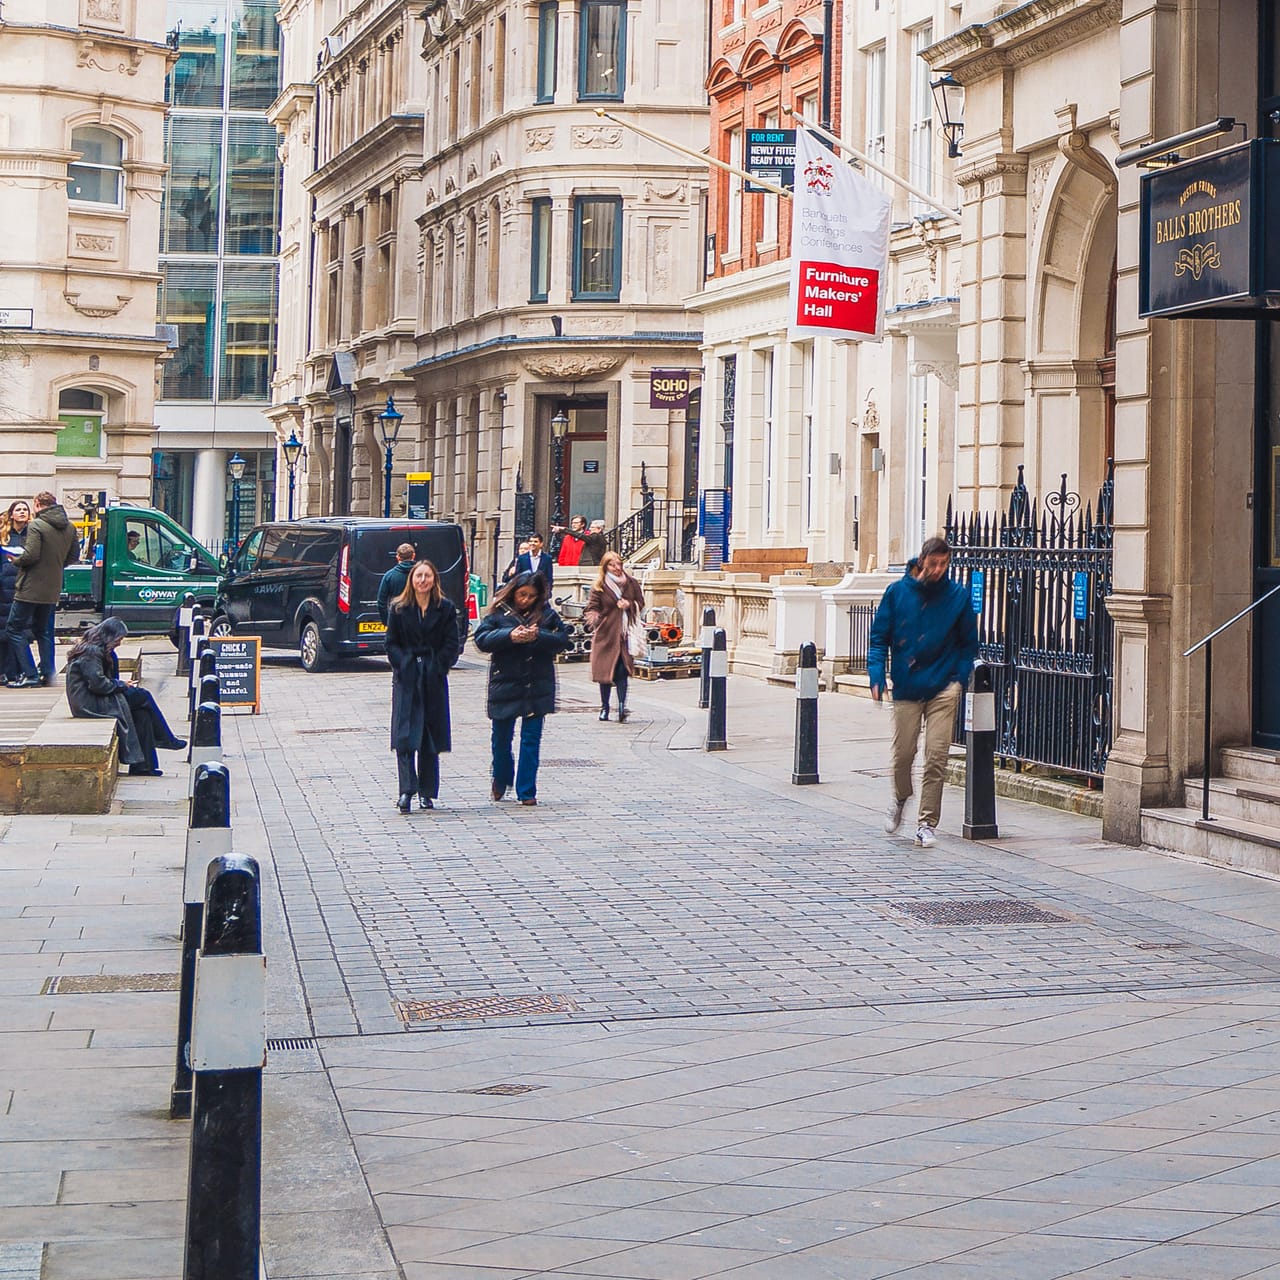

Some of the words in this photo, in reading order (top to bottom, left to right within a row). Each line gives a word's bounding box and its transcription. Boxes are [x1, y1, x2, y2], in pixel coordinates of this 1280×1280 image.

[751, 133, 765, 142] FOR
[767, 133, 785, 142] RENT
[751, 146, 773, 155] NEWLY
[775, 146, 796, 155] FITTE
[751, 156, 773, 165] READY
[774, 156, 784, 165] TO
[1179, 182, 1197, 208] AUSTIN
[1198, 180, 1217, 199] FRIARS
[802, 207, 848, 224] Banquets
[1156, 214, 1186, 244] BALLS
[1188, 199, 1241, 236] BROTHERS
[801, 221, 846, 239] Meetings
[800, 236, 863, 254] Conferences
[805, 267, 869, 288] Furniture
[804, 285, 863, 303] Makers'
[803, 303, 833, 318] Hall
[652, 379, 688, 392] SOHO
[655, 393, 676, 402] COFFEE
[138, 590, 178, 599] CONWAY
[221, 643, 240, 652] CHICK
[241, 643, 247, 652] P
